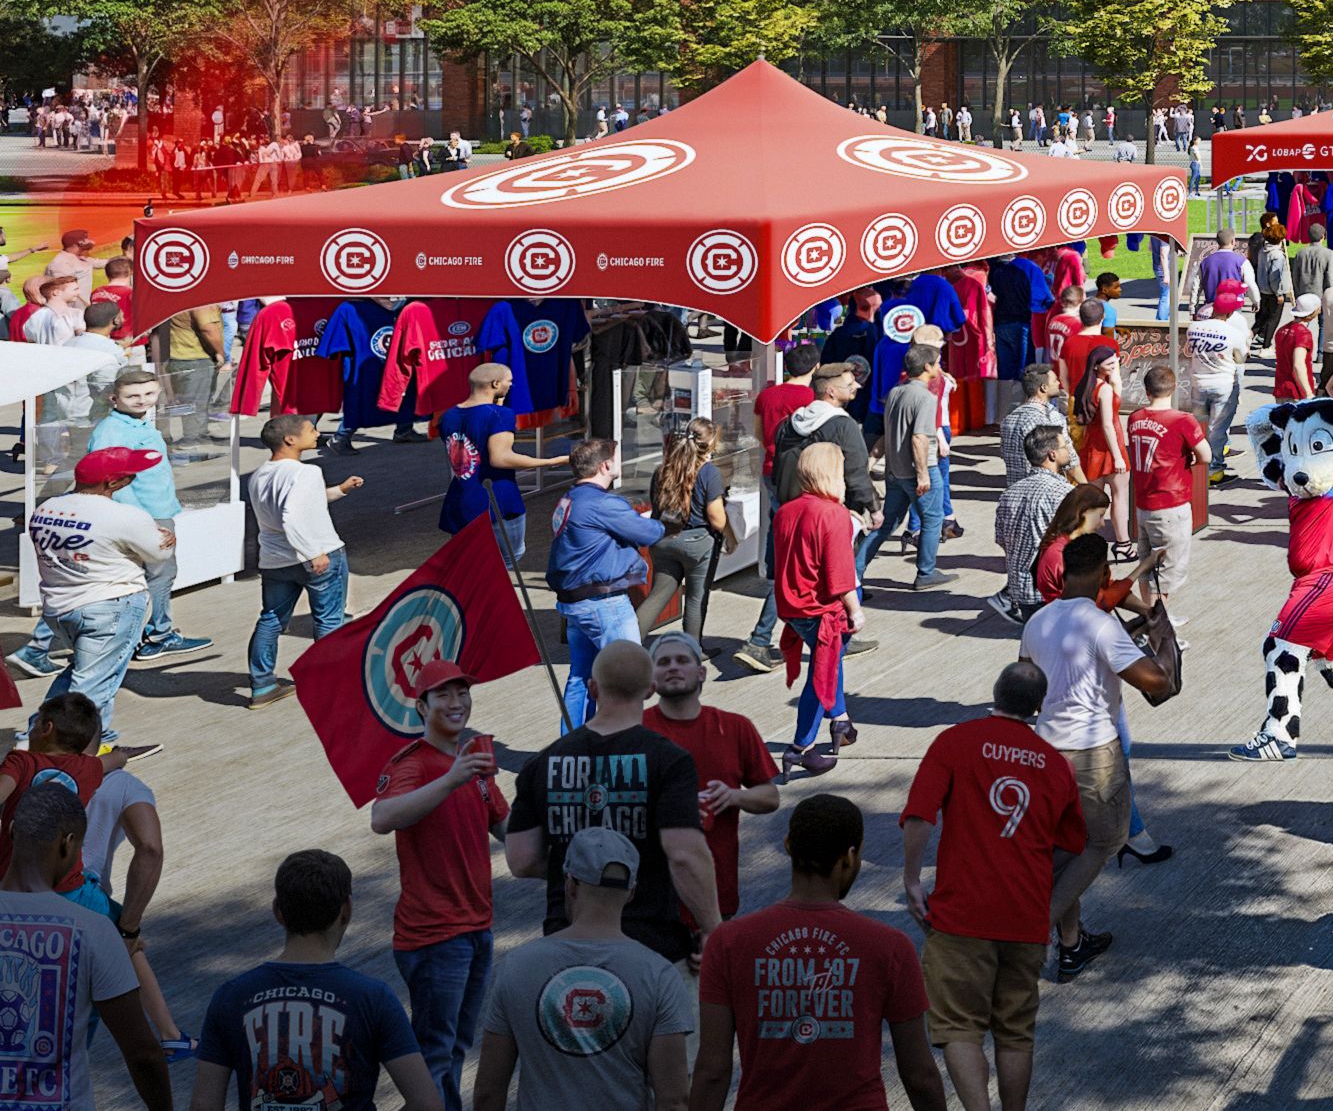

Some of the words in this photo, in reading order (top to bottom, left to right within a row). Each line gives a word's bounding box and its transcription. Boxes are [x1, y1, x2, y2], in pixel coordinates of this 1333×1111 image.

[1272, 147, 1301, 157] LOBAP
[241, 255, 275, 265] CHICAGO
[276, 255, 295, 265] FIRE
[428, 256, 463, 266] CHICAGO
[464, 256, 483, 266] FIRE
[609, 257, 645, 267] CHICAGO
[645, 257, 665, 267] FIRE
[1132, 435, 1158, 472] 17
[31, 515, 92, 531] HICAGO
[982, 742, 1047, 769] CUYPERS
[547, 755, 591, 789] FOR
[989, 776, 1031, 838] 9
[765, 927, 809, 957] CHICAGO
[812, 927, 840, 950] FIRE
[836, 939, 851, 957] FC
[754, 958, 816, 987] FROM
[253, 986, 336, 1004] CHICAGO
[757, 989, 855, 1018] FOREVER
[243, 1000, 346, 1095] FIRE
[25, 1066, 58, 1097] FC
